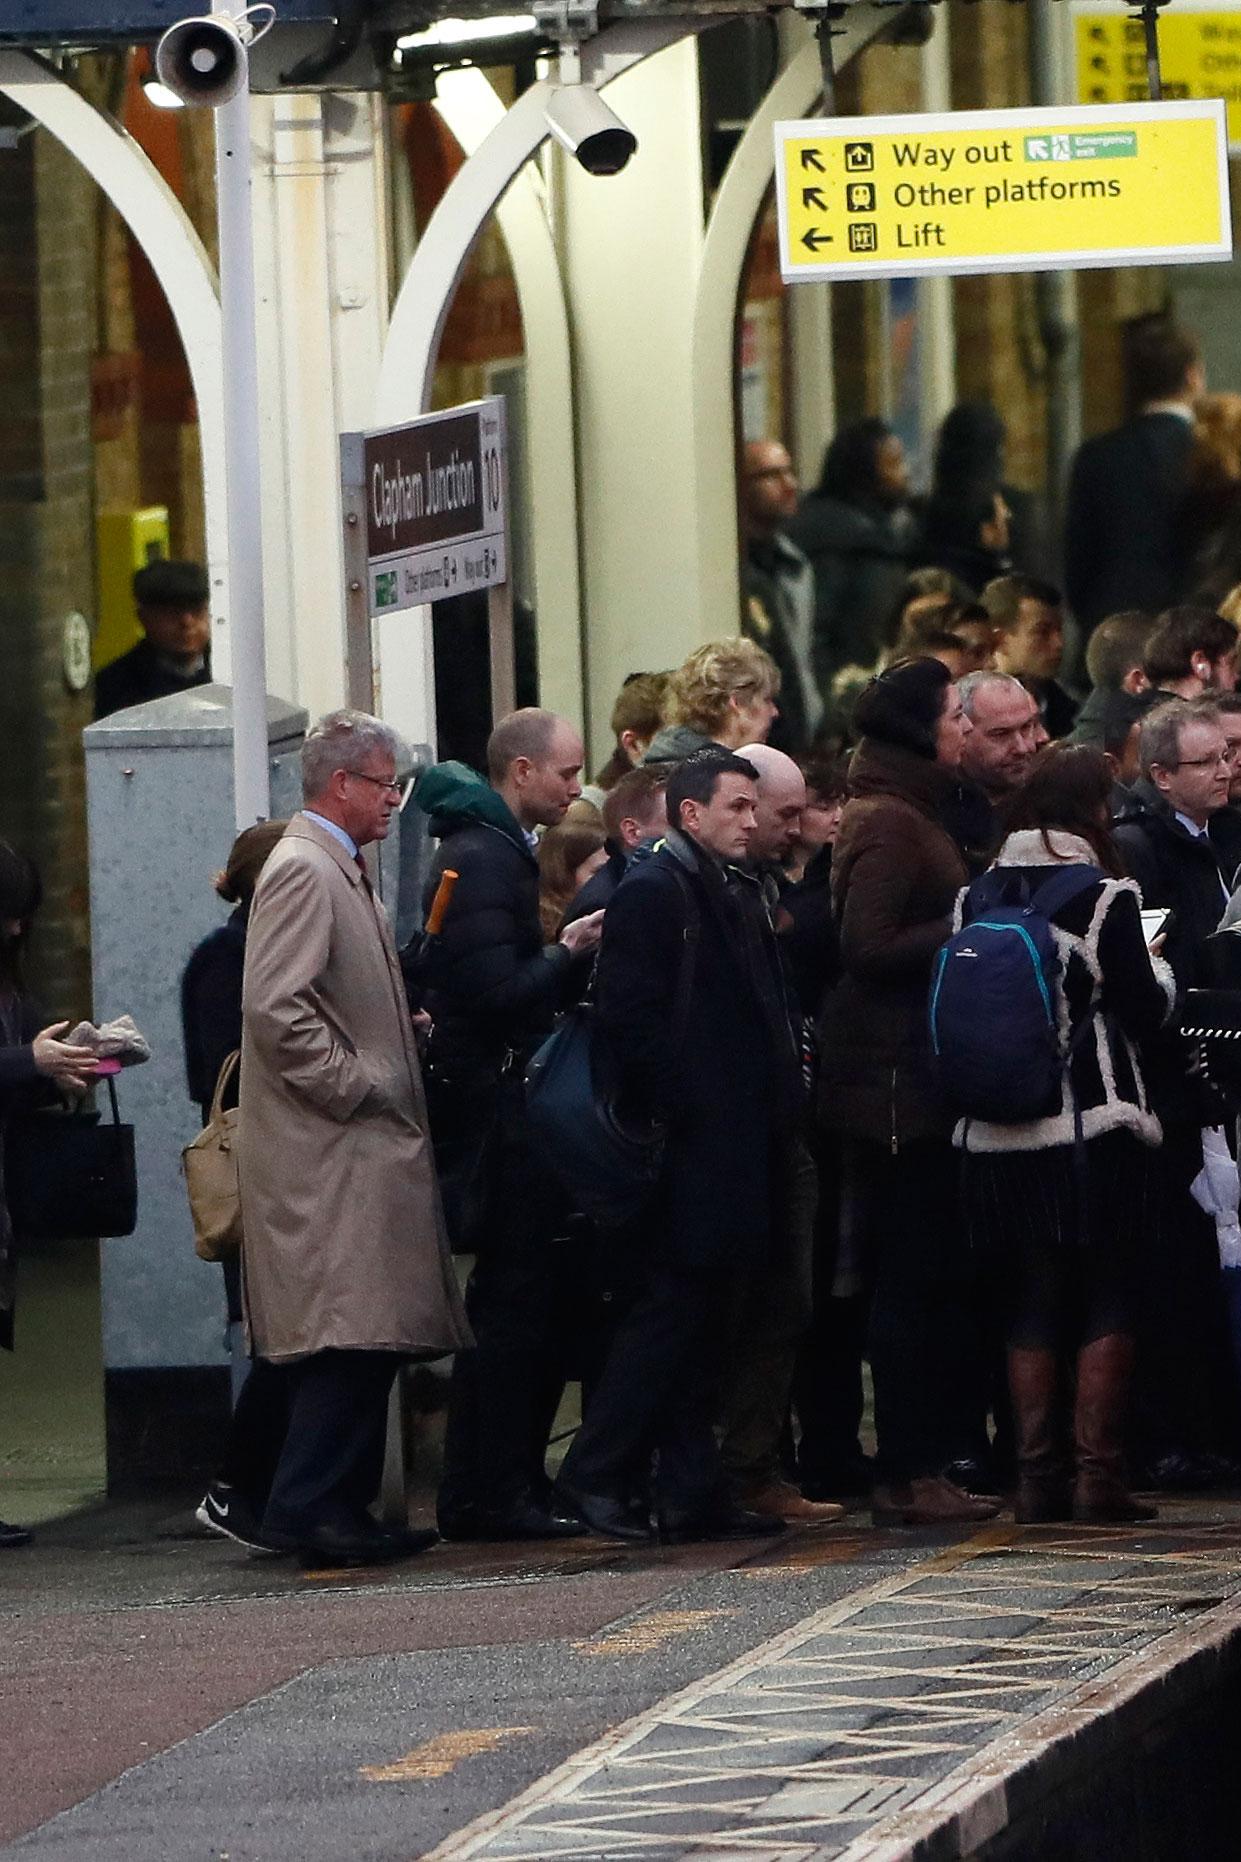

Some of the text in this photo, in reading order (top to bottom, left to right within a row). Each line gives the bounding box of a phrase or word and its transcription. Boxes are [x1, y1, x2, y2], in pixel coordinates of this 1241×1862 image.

[893, 141, 1013, 171] Way out
[894, 176, 1121, 208] Other platforms
[896, 221, 946, 249] Lift
[373, 448, 476, 541] Clapham Junction
[484, 447, 500, 512] 10
